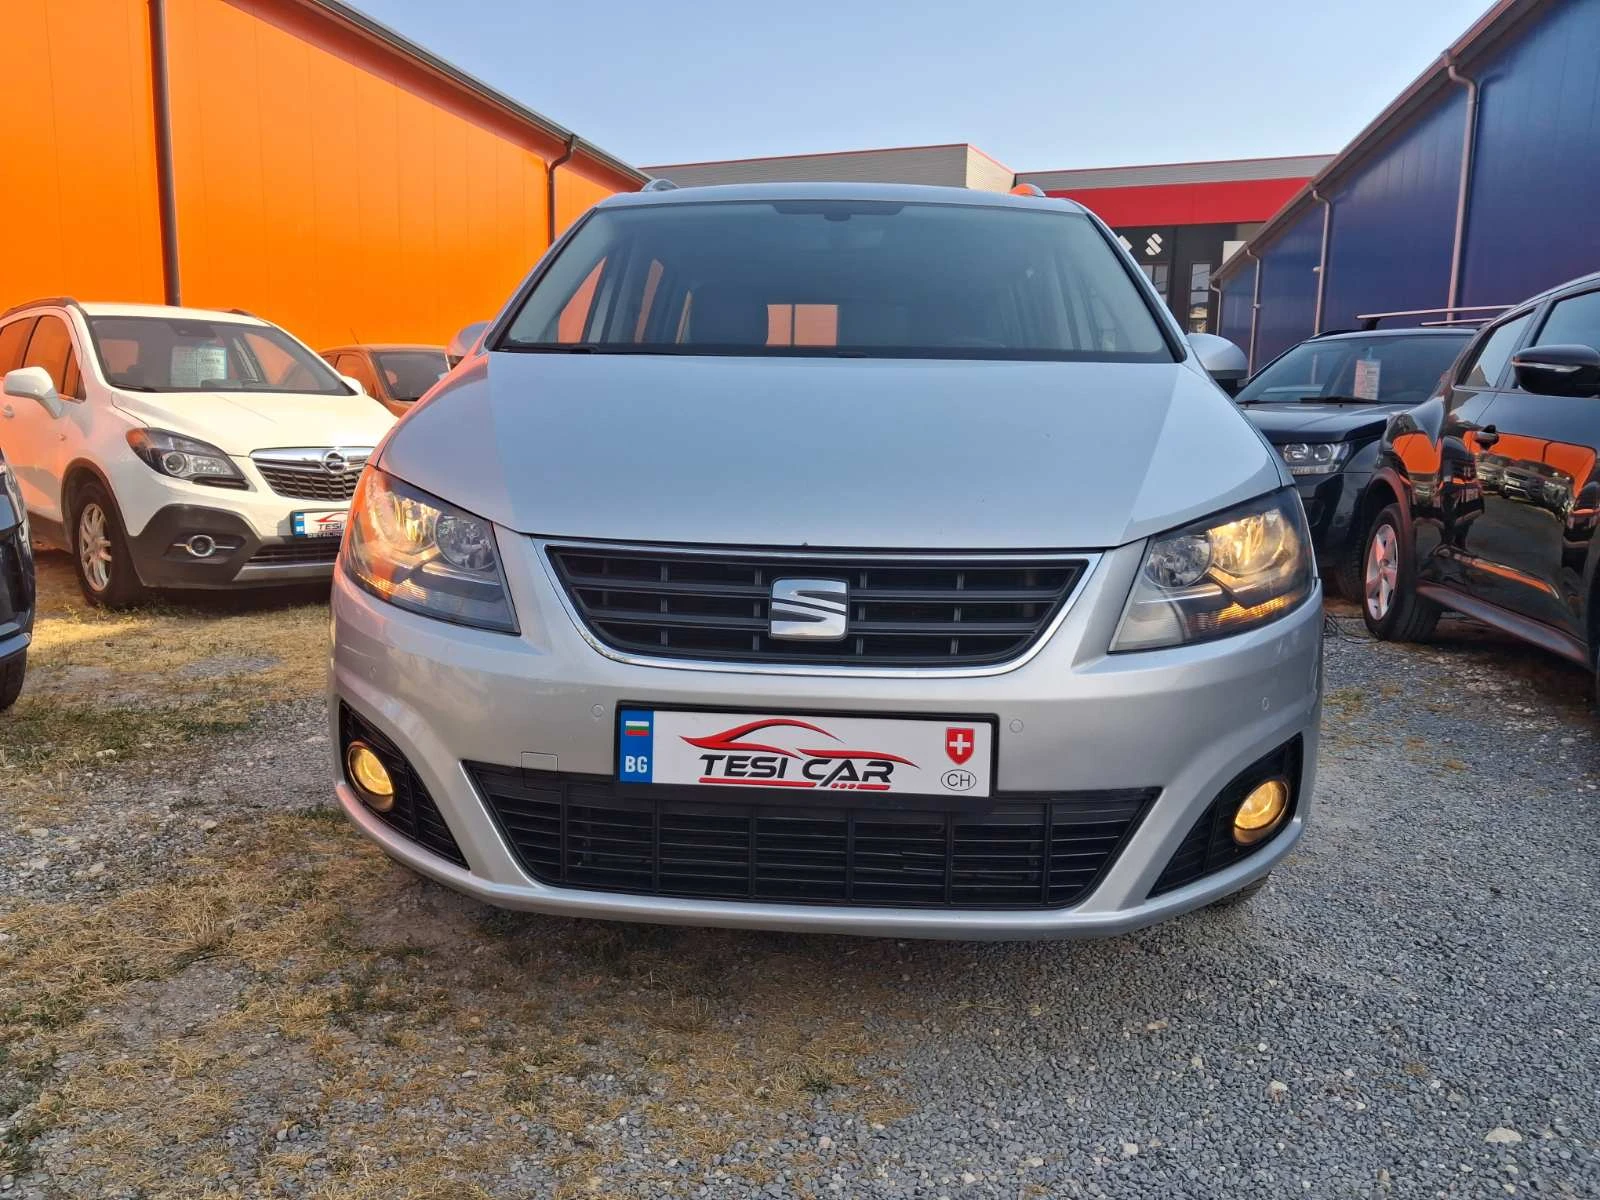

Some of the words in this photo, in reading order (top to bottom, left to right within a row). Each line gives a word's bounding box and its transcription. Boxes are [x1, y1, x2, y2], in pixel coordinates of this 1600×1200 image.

[625, 755, 648, 775] BG
[699, 755, 789, 779] TESI
[802, 758, 894, 786] CAR
[947, 773, 971, 787] CH
